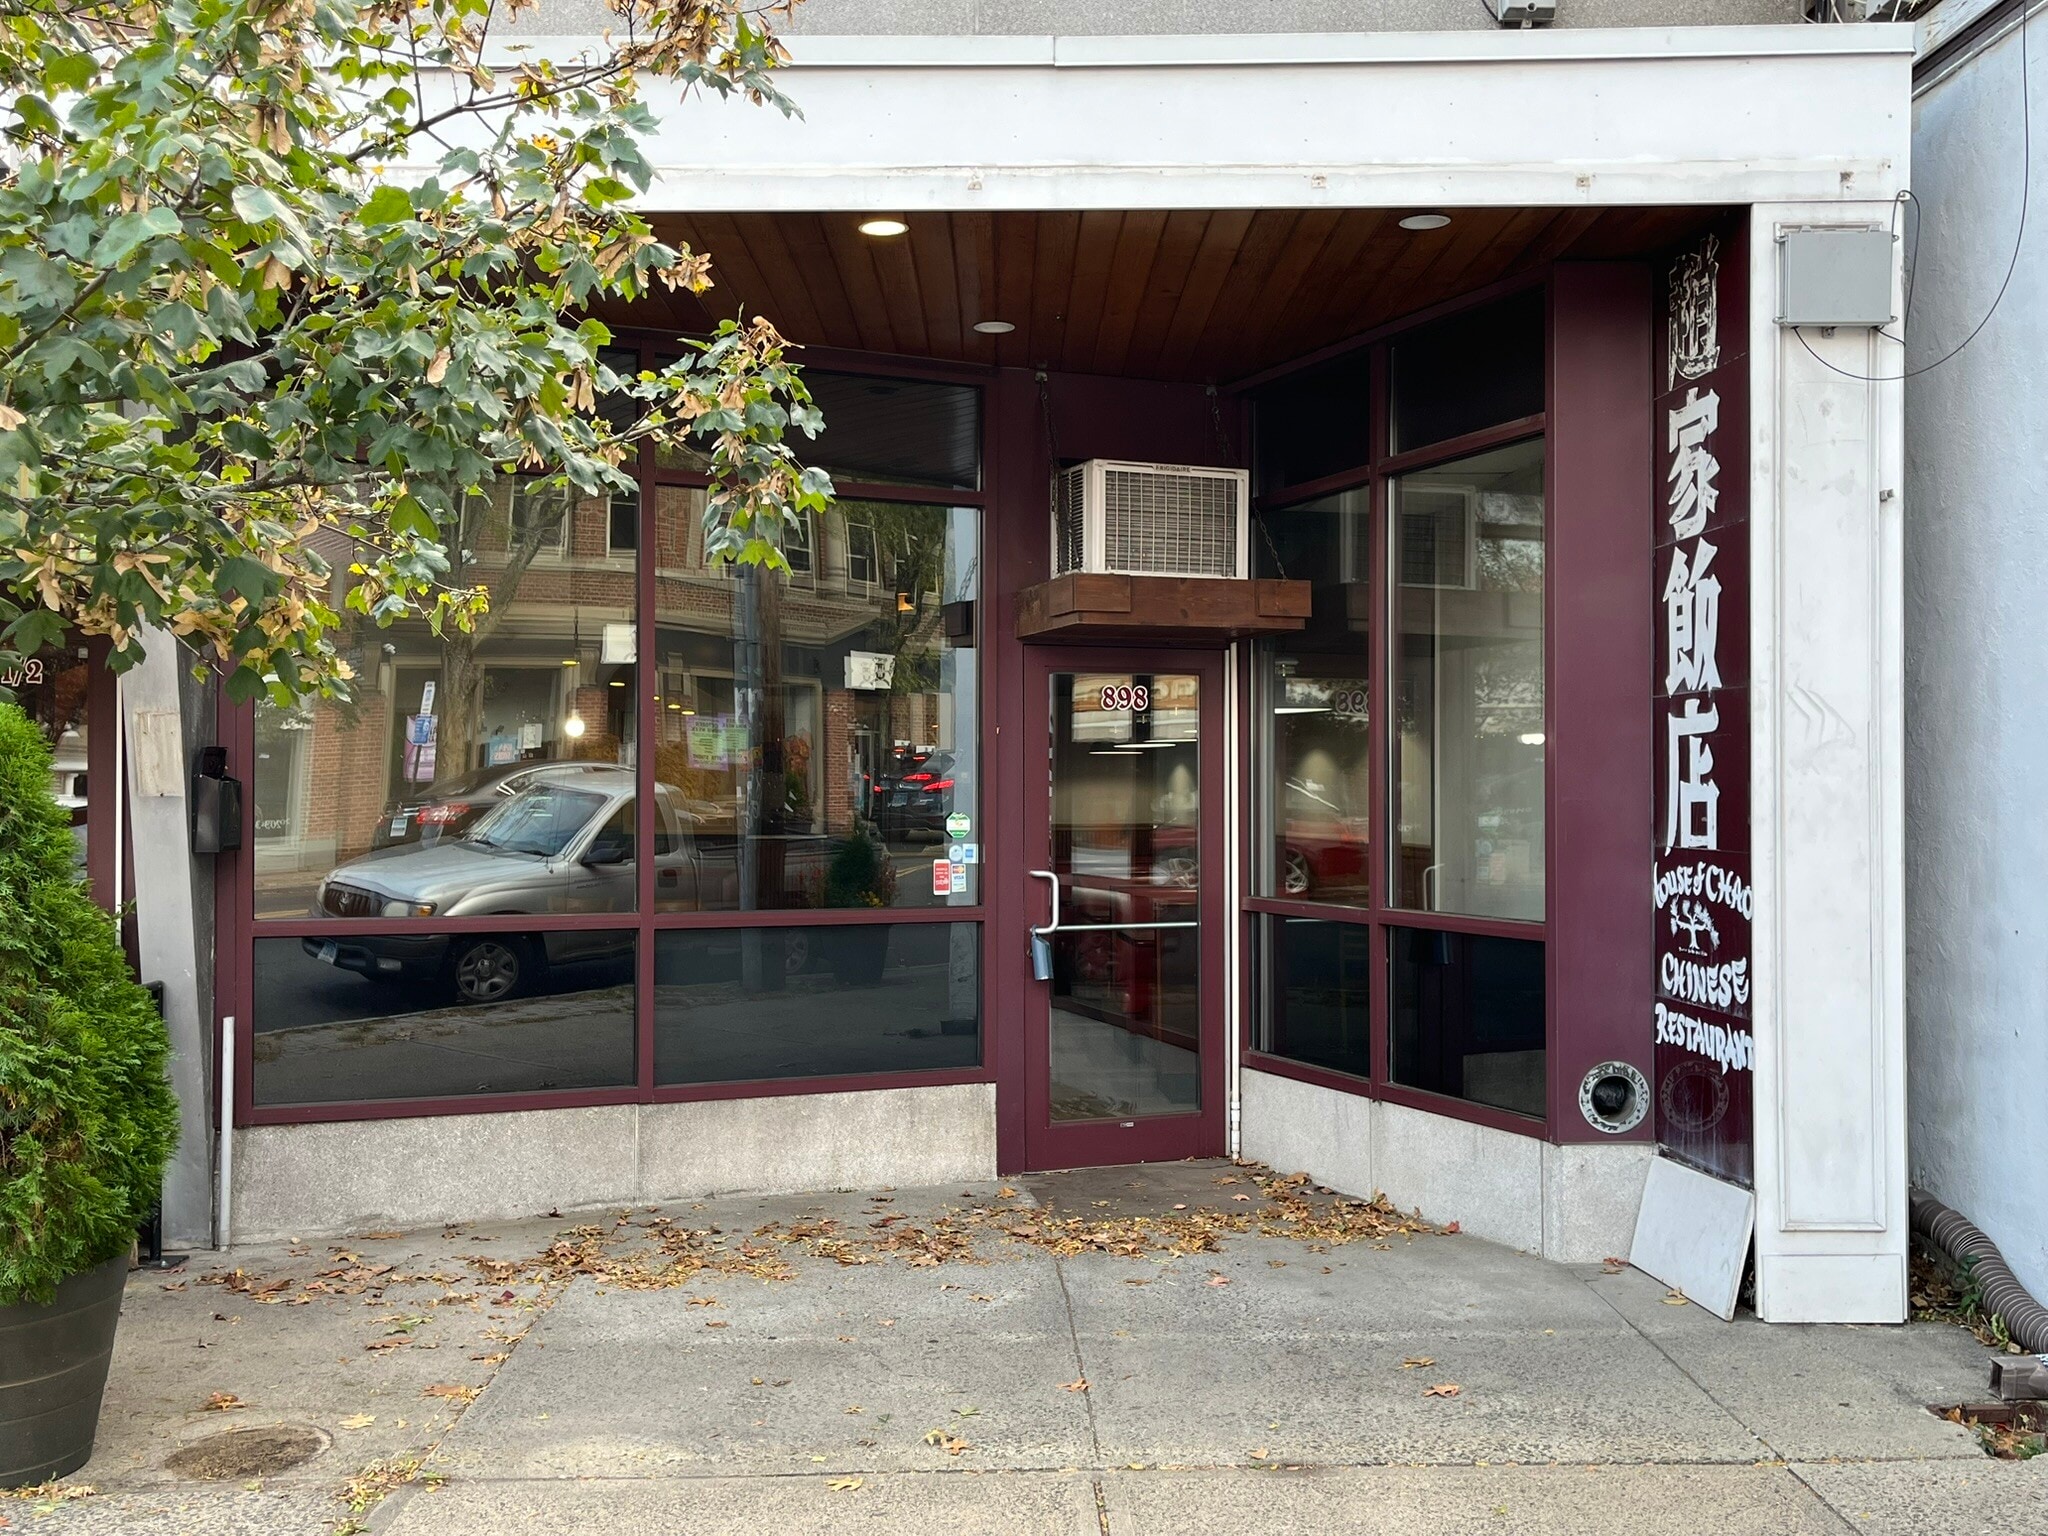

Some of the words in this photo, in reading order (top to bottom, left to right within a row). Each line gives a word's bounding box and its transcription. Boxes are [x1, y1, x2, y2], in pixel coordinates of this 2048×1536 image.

[1101, 684, 1148, 711] 898
[1705, 864, 1753, 920] CHAO
[1661, 951, 1749, 1007] CHINESE
[1655, 1002, 1753, 1076] RESTAURANT
